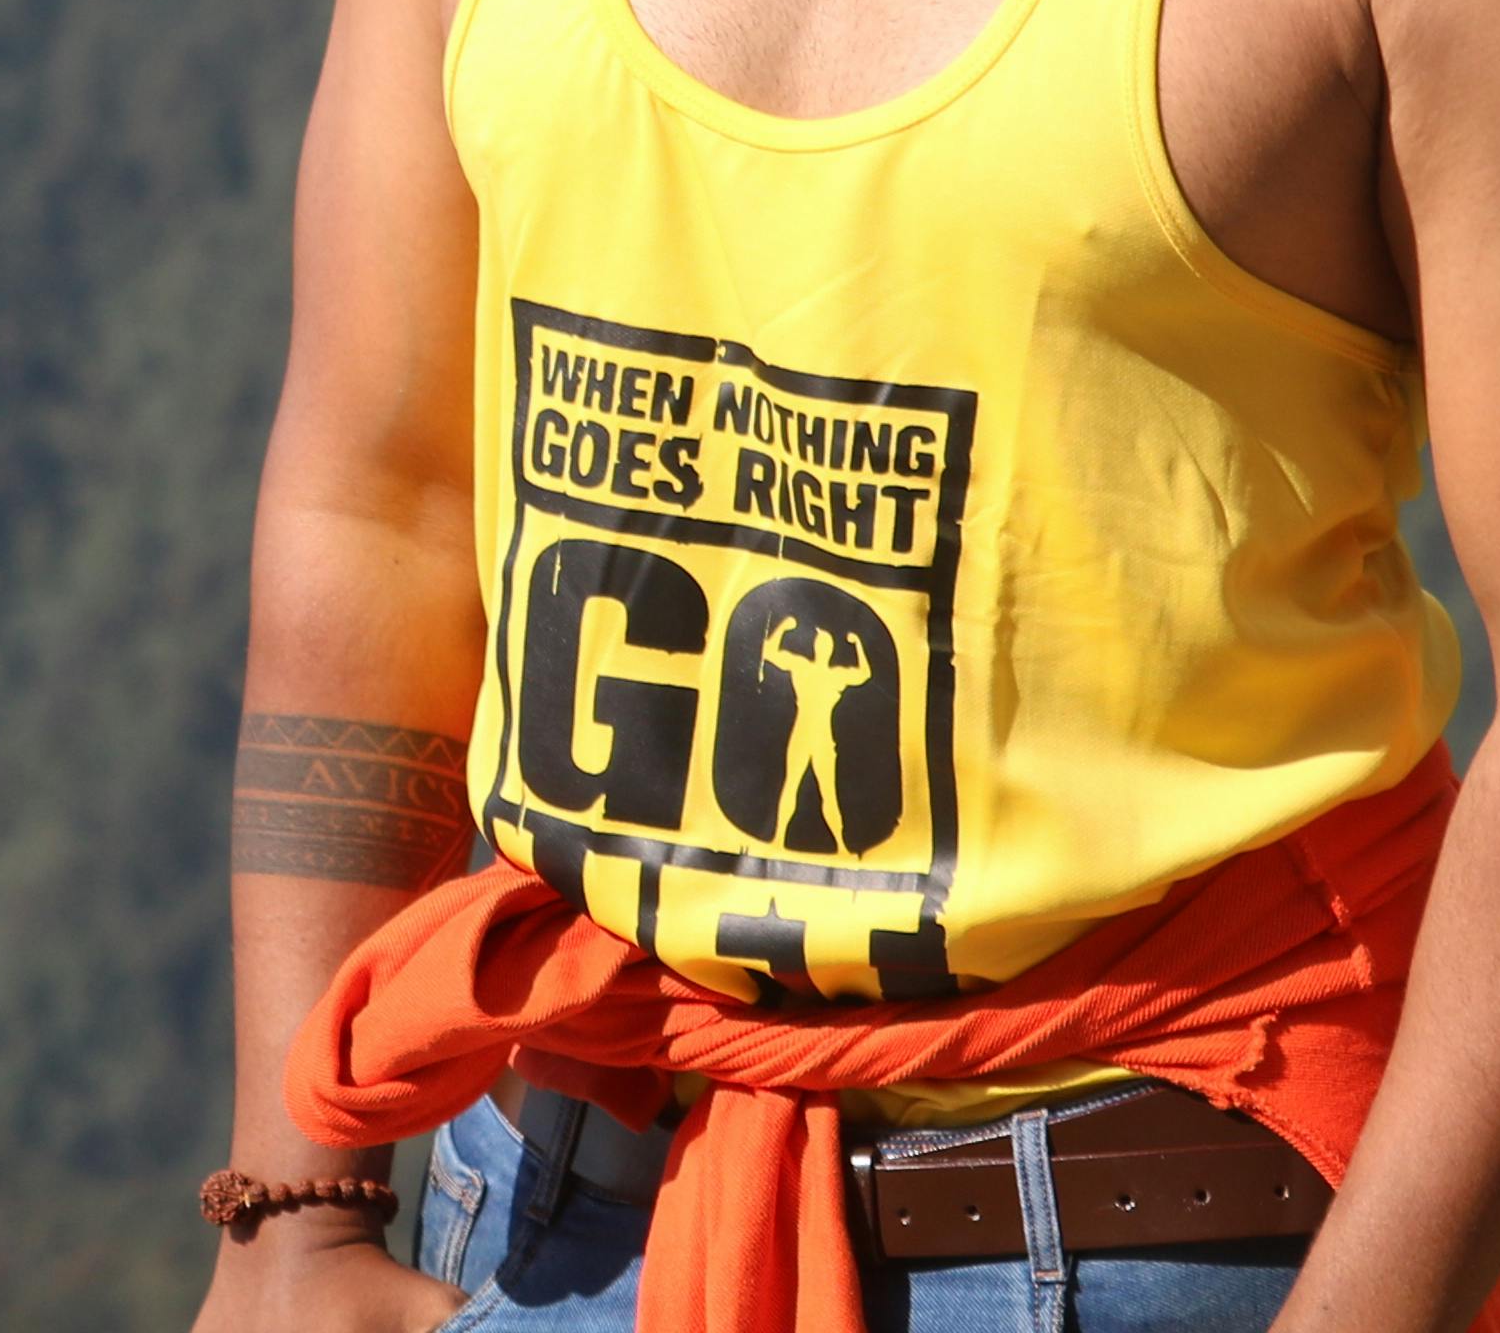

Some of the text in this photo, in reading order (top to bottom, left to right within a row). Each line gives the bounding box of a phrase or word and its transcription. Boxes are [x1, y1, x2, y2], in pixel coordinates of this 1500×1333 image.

[531, 408, 931, 554] GOES RIGHT
[541, 344, 937, 478] WHEN NOTHING
[516, 538, 902, 857] GO
